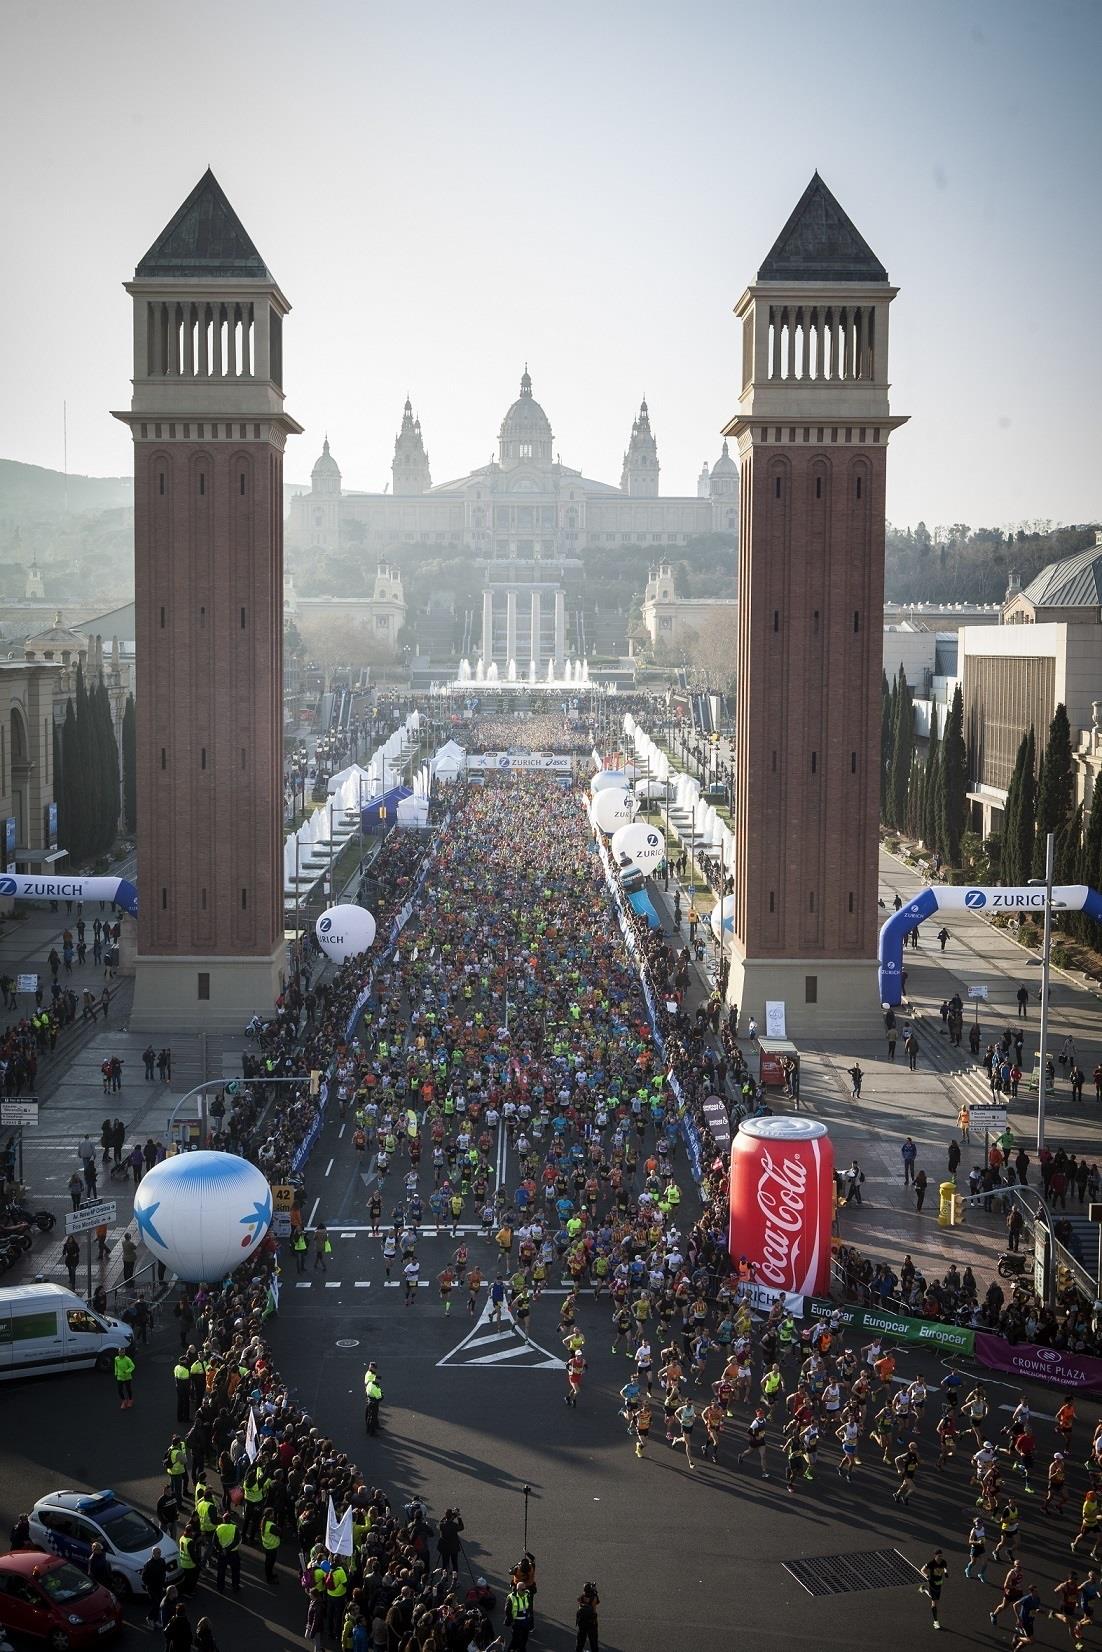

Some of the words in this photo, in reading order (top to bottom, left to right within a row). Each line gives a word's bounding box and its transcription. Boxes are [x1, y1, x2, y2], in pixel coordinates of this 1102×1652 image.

[511, 759, 542, 767] ZURICH
[23, 883, 82, 896] ZURICH
[276, 1189, 290, 1200] 42
[810, 1303, 854, 1321] Euroar
[863, 1314, 910, 1333] Europcar
[919, 1326, 967, 1345] Europcar
[1012, 1356, 1052, 1373] CROWNE
[1055, 1366, 1086, 1381] PLAZA
